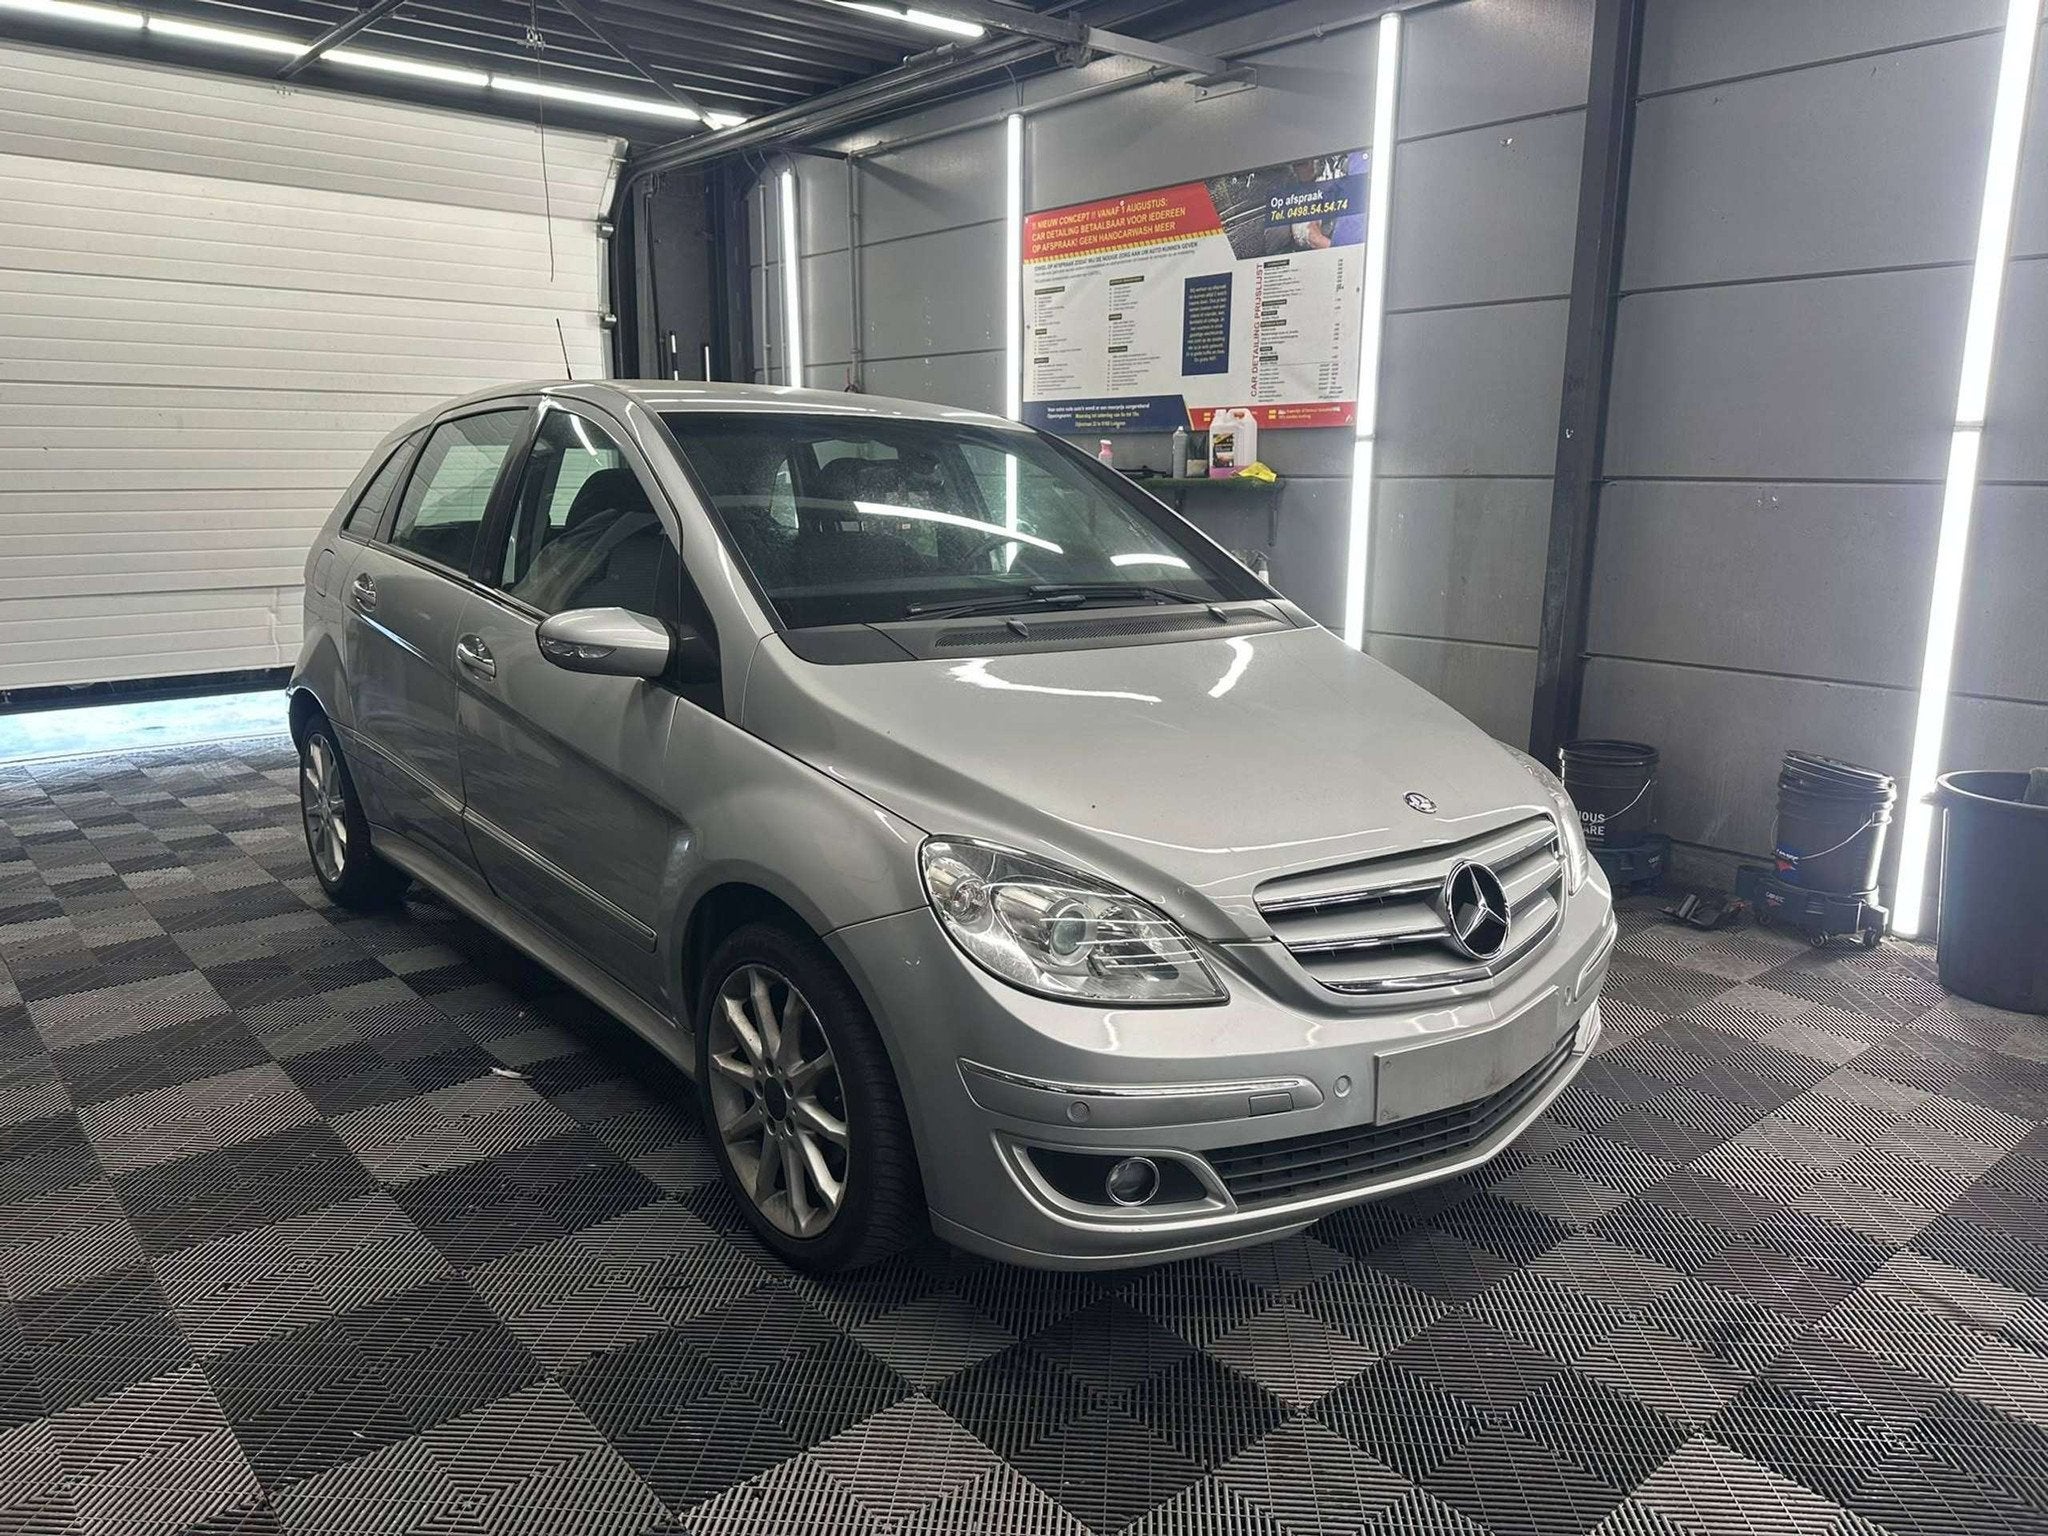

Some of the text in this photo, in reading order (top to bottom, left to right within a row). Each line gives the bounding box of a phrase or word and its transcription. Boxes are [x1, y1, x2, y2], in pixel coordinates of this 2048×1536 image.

[1270, 190, 1324, 209] Op afspraak
[1270, 199, 1348, 221] Tel. 0498.54.54.74
[1032, 231, 1045, 242] CAR
[1046, 225, 1080, 240] DETAILING
[1126, 213, 1148, 225] VOOR
[1148, 207, 1186, 221] IEDEREEN
[1059, 211, 1090, 225] CONCEPT
[1097, 205, 1120, 218] VANAF
[1032, 244, 1042, 254] OP
[1079, 234, 1098, 246] GEEN
[1099, 225, 1153, 242] HANDCARWASH
[1154, 221, 1176, 233] MEER
[1250, 263, 1263, 397] CAR DETAILING PRIJSLIJST
